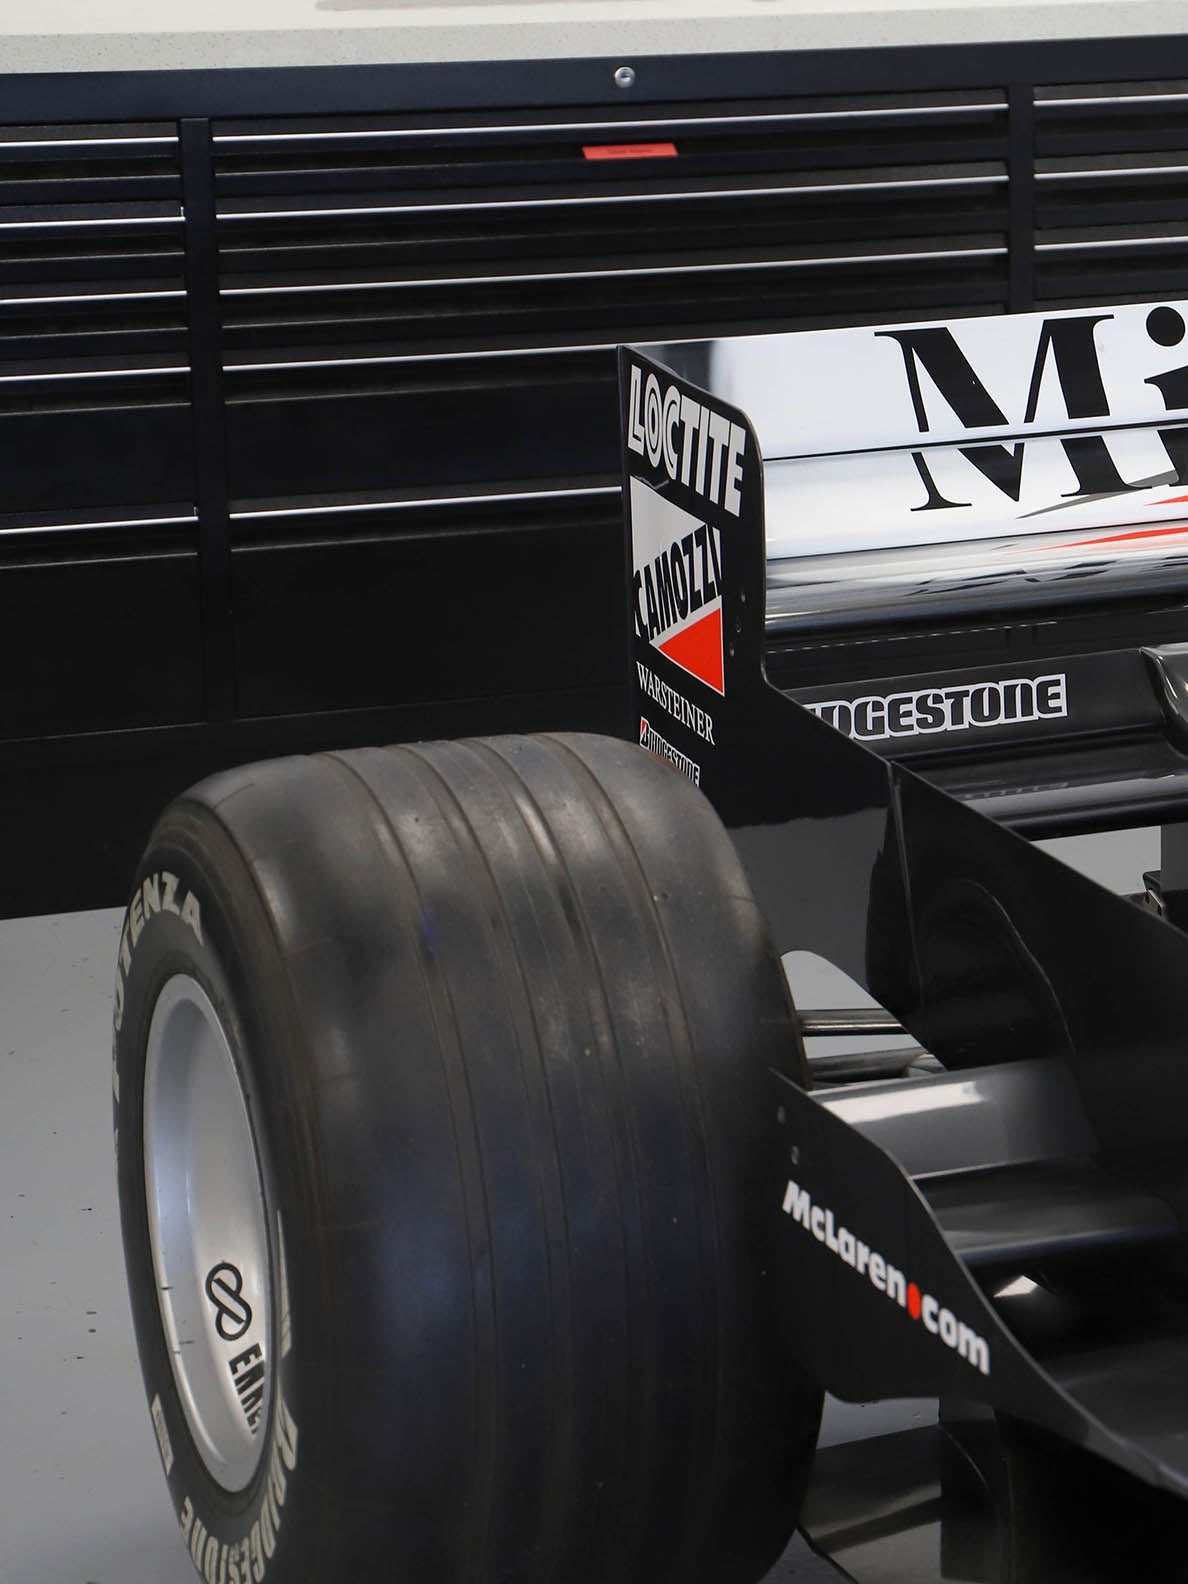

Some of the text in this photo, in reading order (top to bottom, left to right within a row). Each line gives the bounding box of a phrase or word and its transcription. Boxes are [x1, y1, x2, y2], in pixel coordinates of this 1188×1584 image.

[627, 364, 747, 518] LOCTITE
[632, 522, 722, 641] CAMOZZI
[635, 661, 716, 747] WARSTEINER
[800, 673, 1068, 742] DGESTONE
[639, 716, 701, 789] BRIDGESTONE
